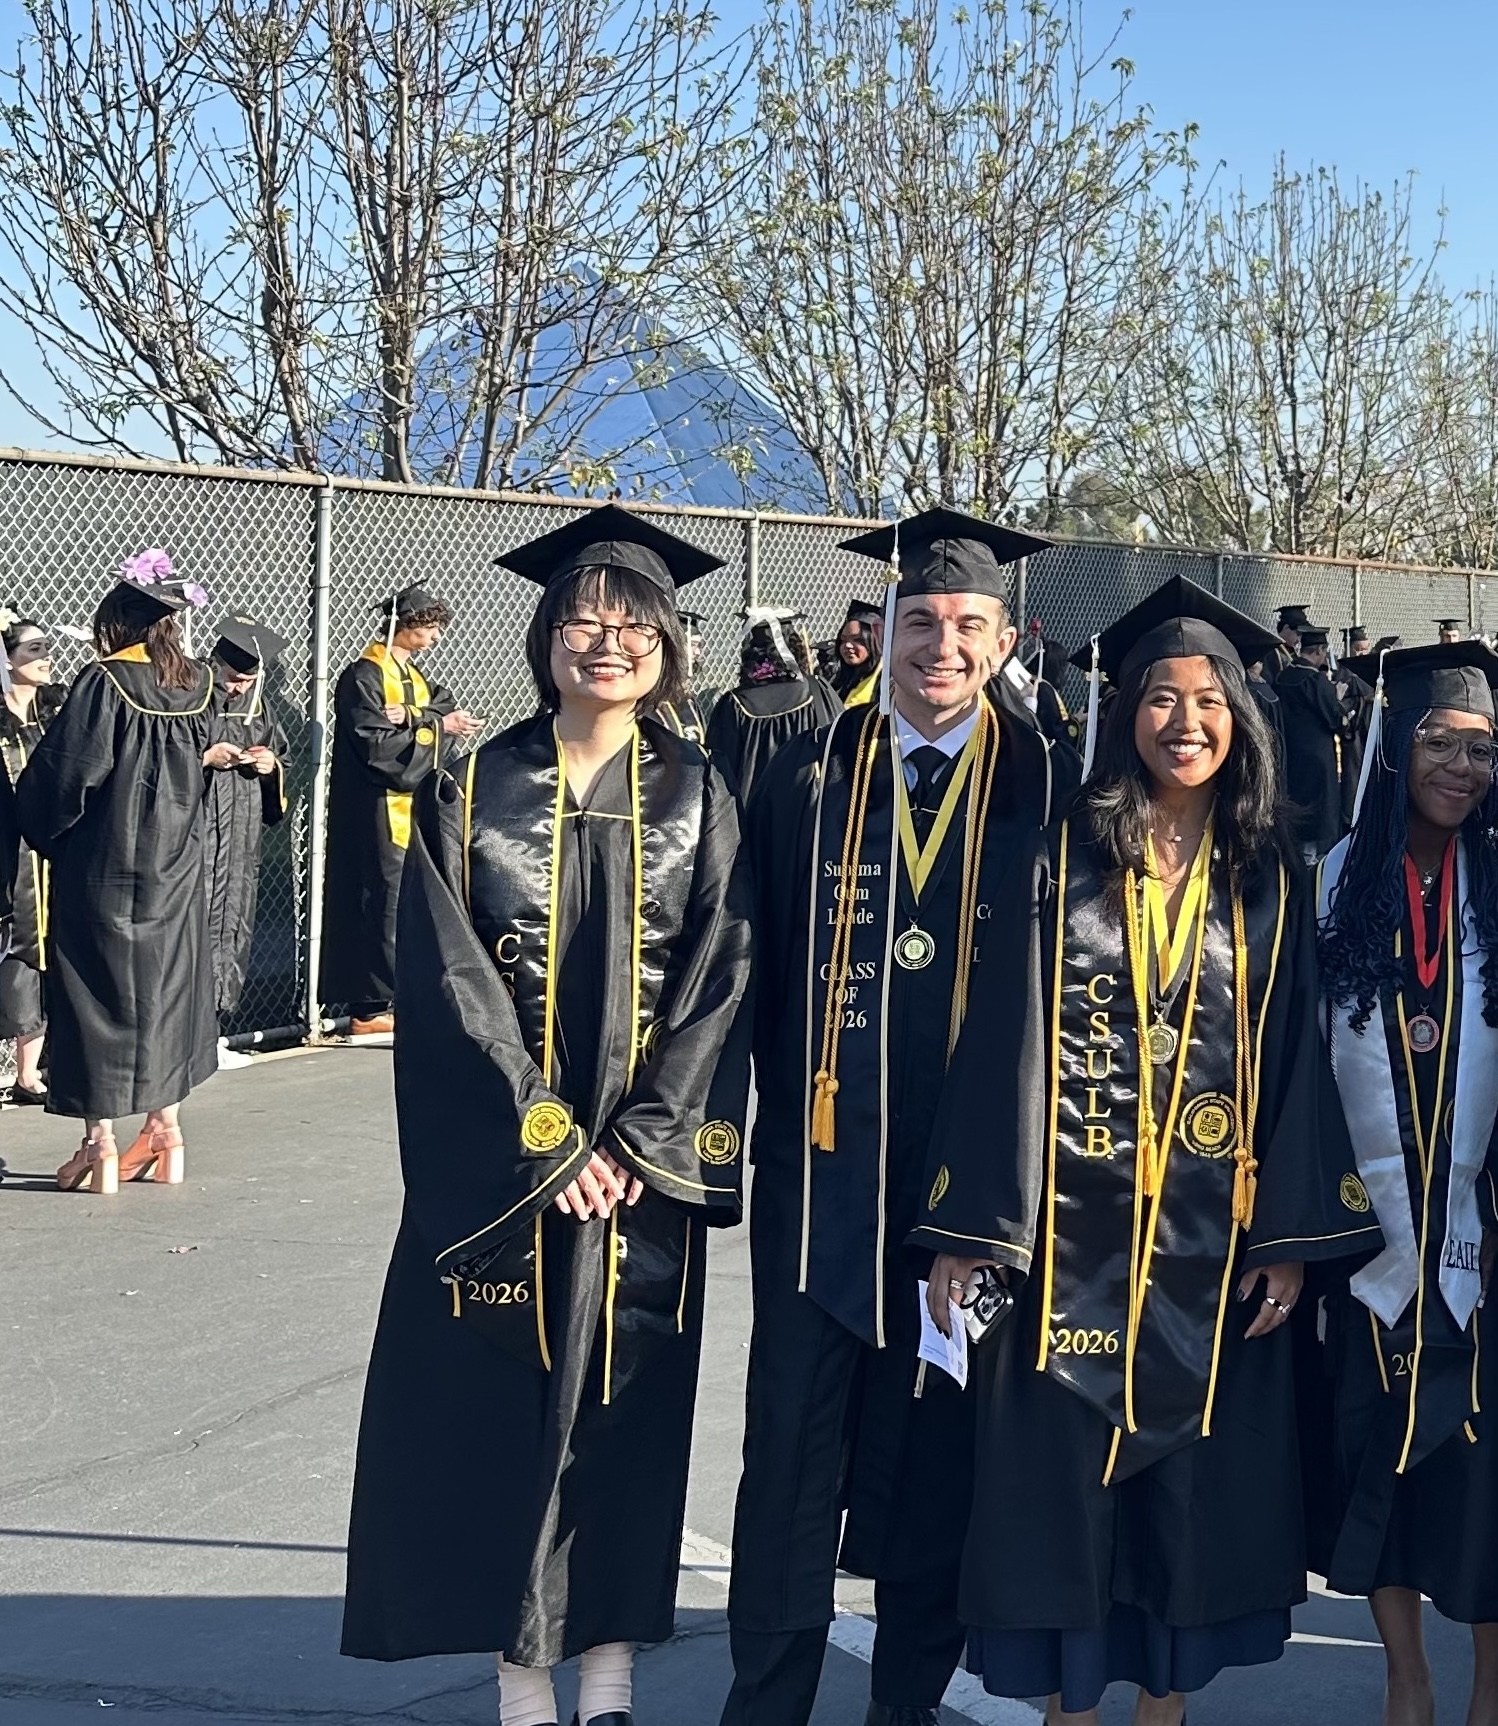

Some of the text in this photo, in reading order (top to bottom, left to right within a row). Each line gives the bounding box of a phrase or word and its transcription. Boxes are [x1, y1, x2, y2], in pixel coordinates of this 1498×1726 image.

[835, 986, 859, 1004] OF
[466, 1280, 529, 1305] 2026
[1055, 1328, 1120, 1355] 2026
